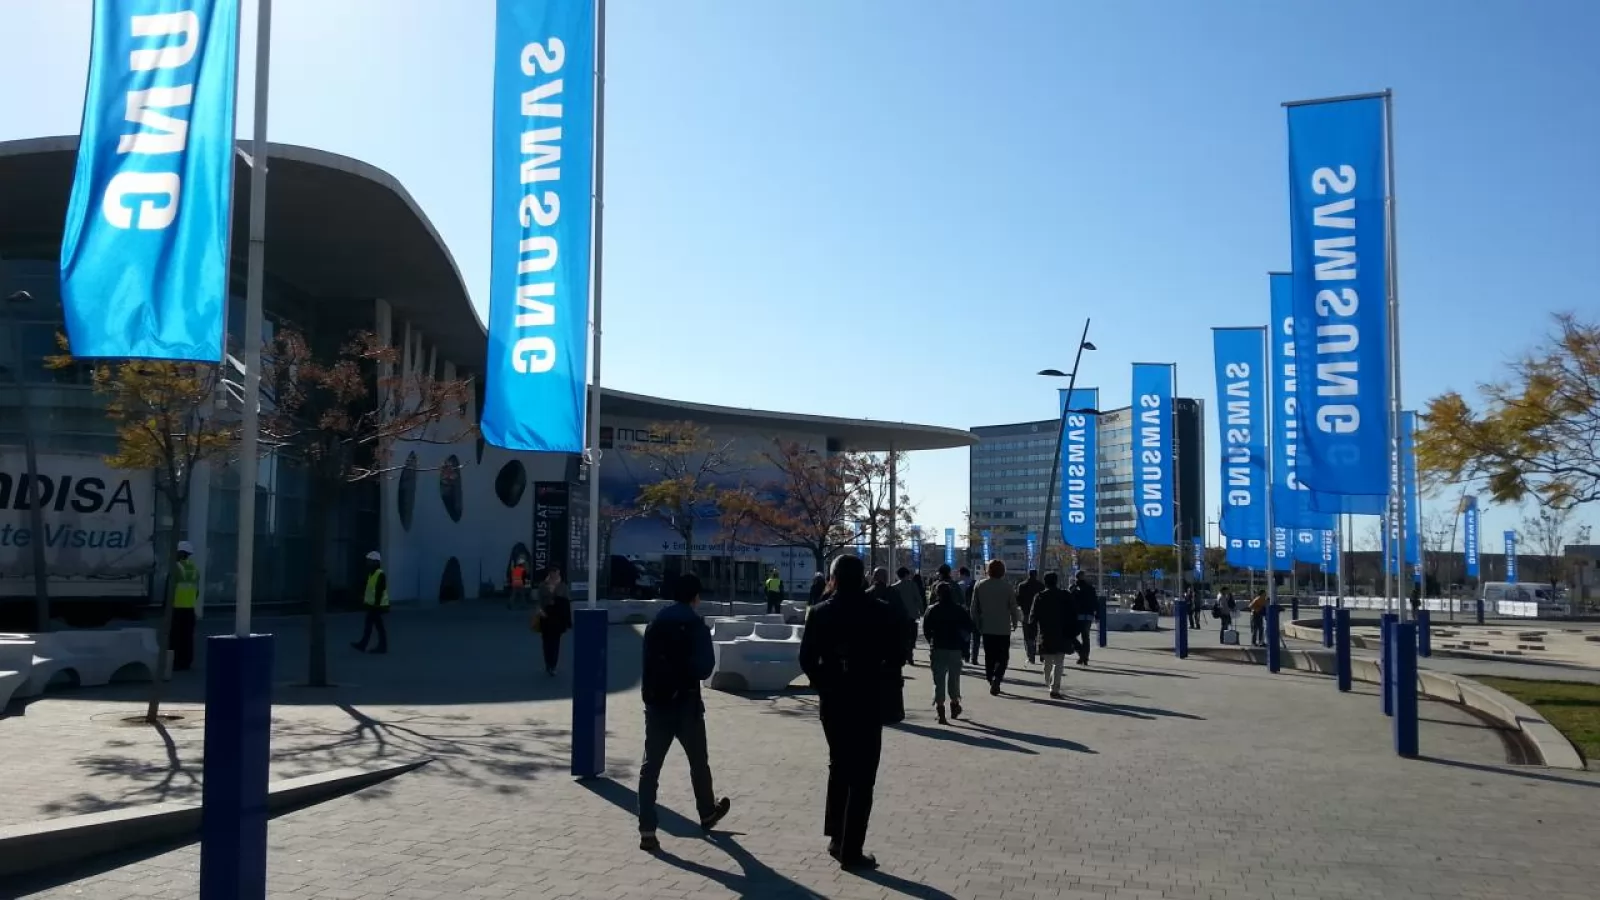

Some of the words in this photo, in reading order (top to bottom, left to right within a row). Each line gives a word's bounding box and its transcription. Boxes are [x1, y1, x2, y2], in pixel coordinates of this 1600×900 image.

[536, 503, 548, 519] AT
[45, 523, 134, 549] Visual
[536, 521, 547, 539] US
[535, 540, 547, 571] VISIT
